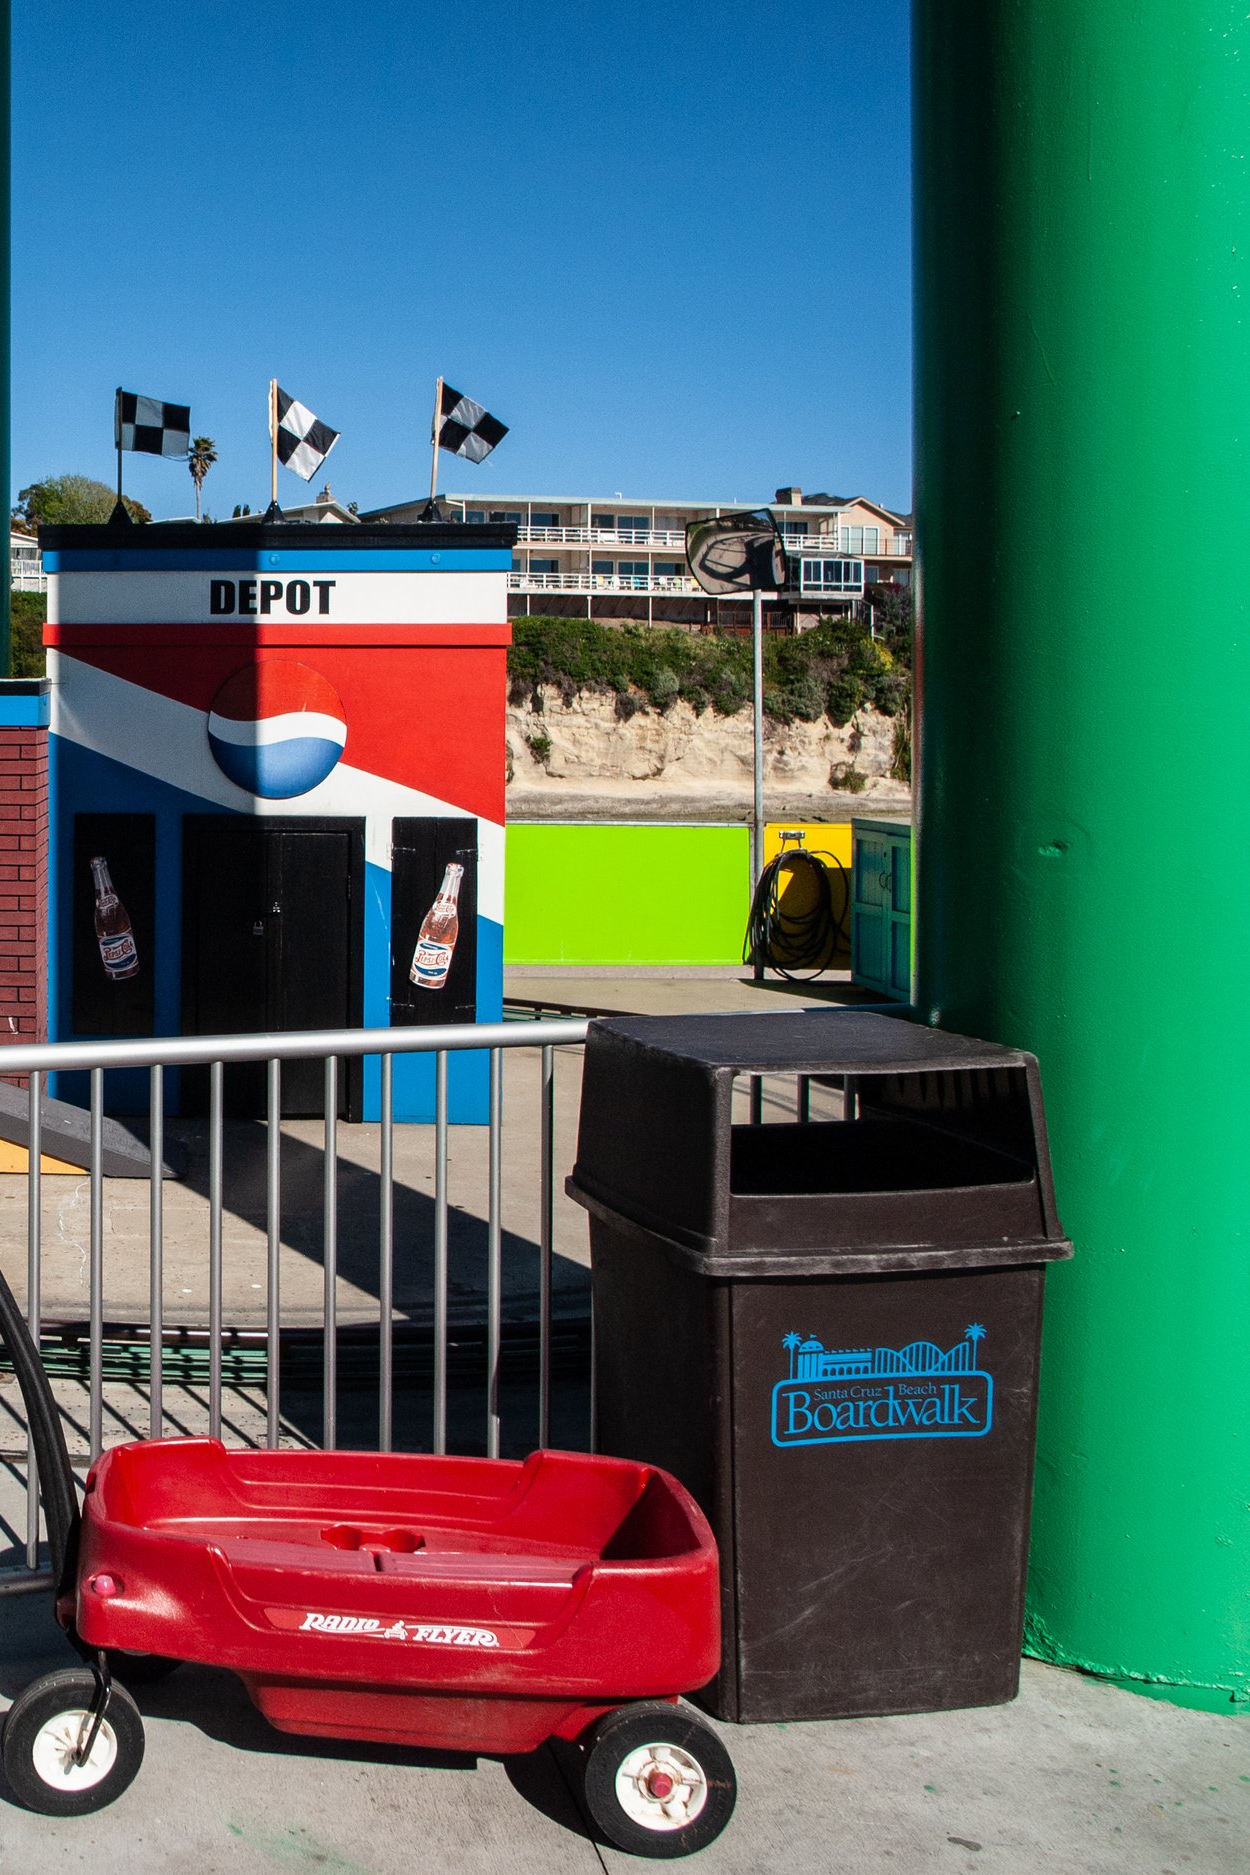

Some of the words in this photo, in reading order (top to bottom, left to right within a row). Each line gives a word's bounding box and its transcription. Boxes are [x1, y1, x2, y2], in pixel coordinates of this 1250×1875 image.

[210, 580, 336, 615] DEPOT
[813, 1388, 848, 1401] Santa
[850, 1385, 882, 1399] Cruz
[898, 1382, 938, 1395] Beach
[782, 1384, 980, 1435] Boardwalk
[299, 1612, 382, 1634] RADIO
[412, 1626, 499, 1648] FLYER
